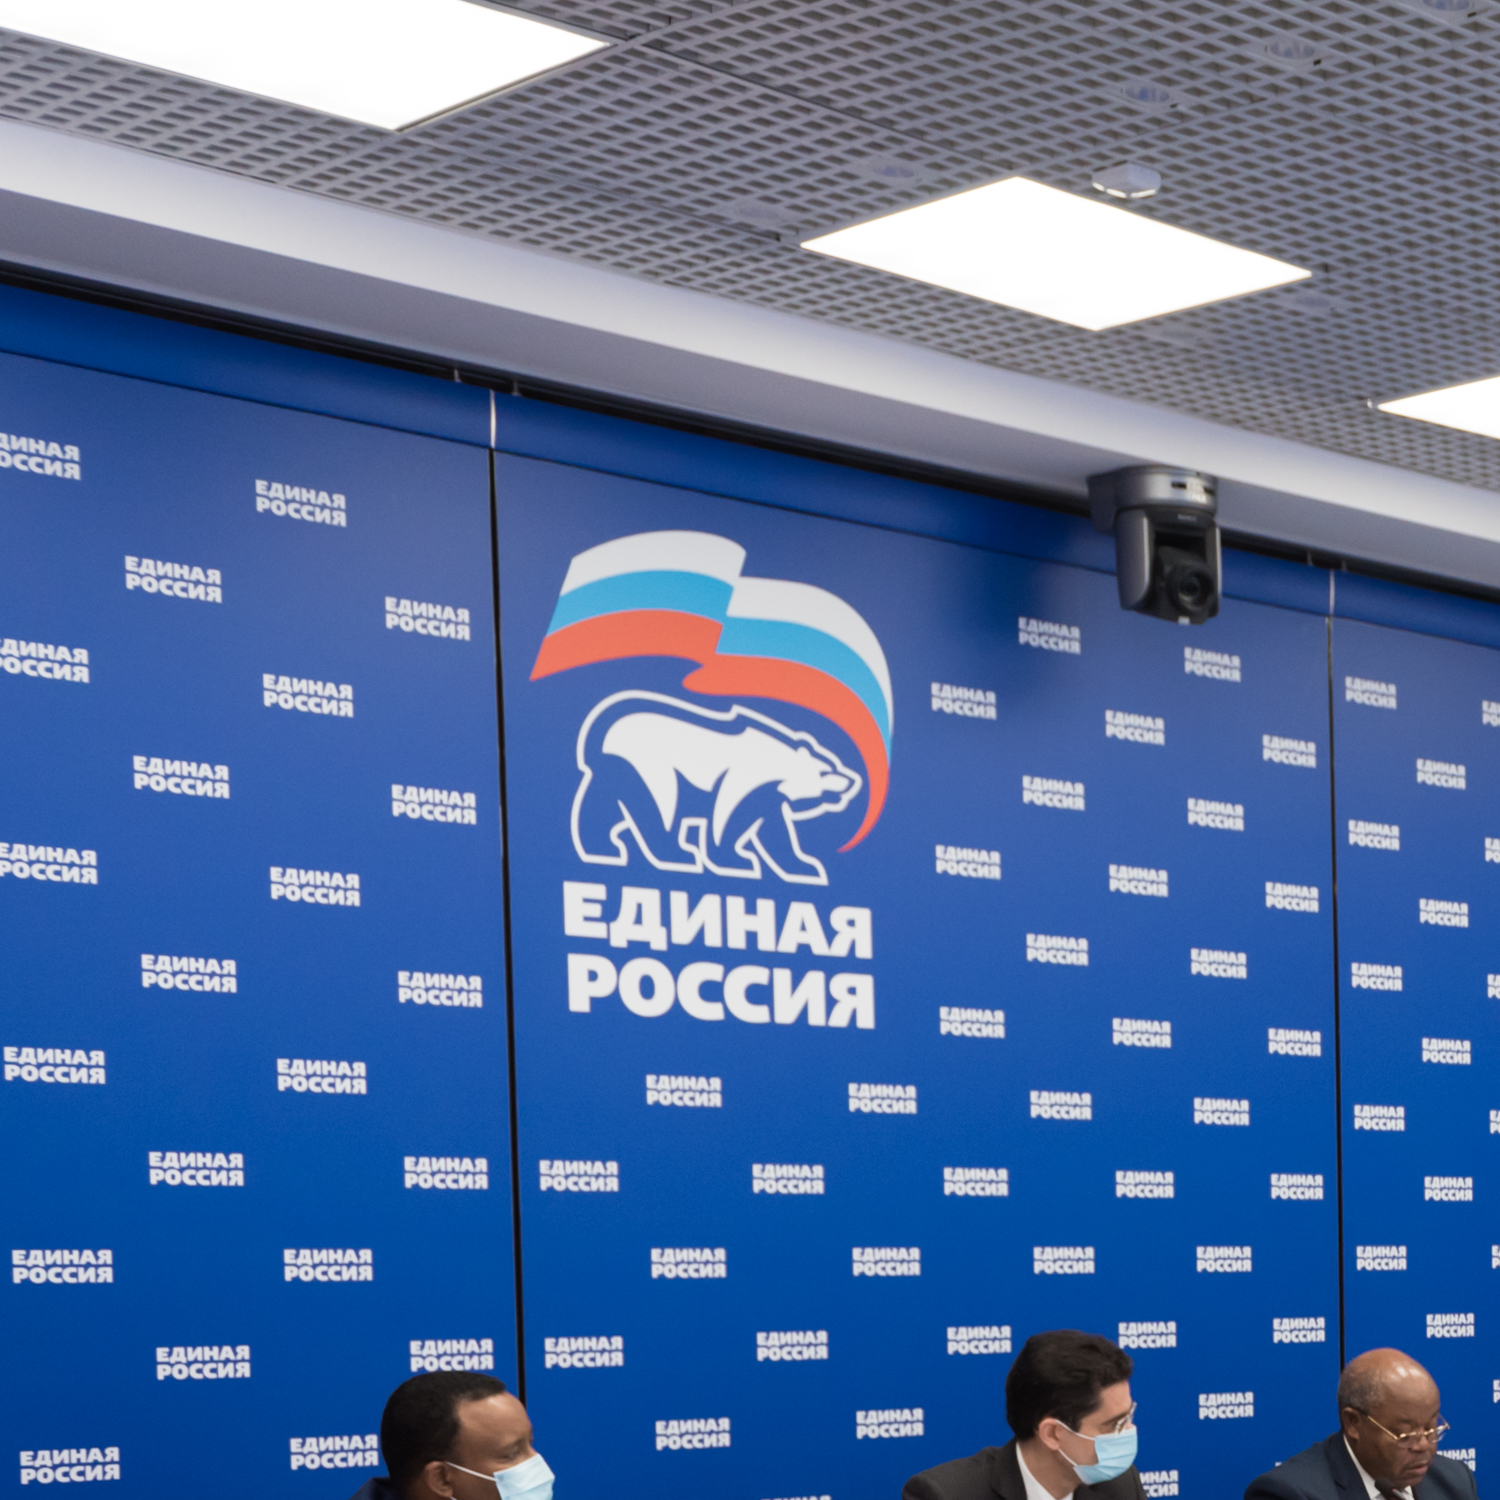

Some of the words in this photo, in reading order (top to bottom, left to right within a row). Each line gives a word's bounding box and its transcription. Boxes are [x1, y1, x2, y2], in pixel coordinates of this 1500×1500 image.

[0, 433, 80, 461] ДИНАЯ
[0, 450, 80, 480] ОССИЯ
[256, 480, 346, 509] ЕДИНАЯ
[256, 496, 346, 527] РОССИЯ
[125, 556, 221, 585] ЕДИНАЯ
[126, 573, 222, 603] РОССИЯ
[385, 596, 470, 624] ЕДИНАЯ
[386, 613, 470, 640] РОССИЯ
[0, 638, 88, 664] ДИНАЯ
[263, 674, 352, 700] ЕДИНАЯ
[931, 682, 996, 706] ЕДИНАЯ
[264, 690, 353, 717] РОССИЯ
[932, 696, 996, 720] РОССИЯ
[1105, 710, 1164, 732] ЕДИНАЯ
[1106, 723, 1165, 745] РОССИЯ
[133, 756, 229, 781] ЕДИНАЯ
[134, 773, 230, 798] РОССИЯ
[392, 784, 476, 808] ЕДИНАЯ
[392, 800, 476, 824] РОССИЯ
[1188, 798, 1244, 818] ЕДИНАЯ
[1188, 811, 1244, 831] РОССИЯ
[1348, 820, 1400, 838] ЕДИНАЯ
[1349, 832, 1400, 850] РОССИЯ
[936, 845, 1000, 866] ЕДИНАЯ
[270, 867, 360, 889] ЕДИНАЯ
[936, 859, 1001, 880] РОССИЯ
[1109, 864, 1168, 884] ЕДИНАЯ
[271, 883, 360, 906] РОССИЯ
[1109, 878, 1168, 897] РОССИЯ
[1266, 882, 1318, 900] ЕДИНАЯ
[1266, 894, 1319, 912] РОССИЯ
[1420, 898, 1468, 916] ЕДИНАЯ
[563, 881, 873, 959] ЕДИНАЯ
[1420, 910, 1468, 928] РОССИЯ
[1026, 934, 1088, 952] ЕДИНАЯ
[141, 954, 236, 975] ЕДИНАЯ
[1026, 947, 1088, 966] РОССИЯ
[1191, 948, 1246, 966] ЕДИНАЯ
[1191, 961, 1247, 979] РОССИЯ
[142, 971, 237, 993] РОССИЯ
[398, 971, 482, 991] ЕДИНАЯ
[398, 987, 482, 1008] РОССИЯ
[567, 953, 875, 1029] РОССИЯ
[940, 1006, 1004, 1024] ЕДИНАЯ
[940, 1020, 1005, 1038] РОССИЯ
[1112, 1018, 1171, 1035] ЕДИНАЯ
[1113, 1031, 1171, 1048] РОССИЯ
[4, 1047, 105, 1066] ЕДИНАЯ
[4, 1064, 106, 1084] РОССИЯ
[277, 1058, 366, 1077] ЕДИНАЯ
[278, 1075, 366, 1094] РОССИЯ
[646, 1074, 722, 1092] ЕДИНАЯ
[848, 1083, 916, 1100] ЕДИНАЯ
[646, 1089, 722, 1107] РОССИЯ
[849, 1097, 917, 1114] РОССИЯ
[1194, 1098, 1249, 1112] ЕДИНАЯ
[1194, 1110, 1250, 1126] РОССИЯ
[149, 1152, 243, 1168] ЕДИНАЯ
[404, 1156, 488, 1173] ЕДИНАЯ
[539, 1160, 618, 1176] ЕДИНАЯ
[150, 1168, 244, 1186] РОССИЯ
[404, 1172, 488, 1189] РОССИЯ
[752, 1164, 824, 1180] ЕДИНАЯ
[944, 1167, 1008, 1182] ЕДИНАЯ
[540, 1175, 619, 1192] РОССИЯ
[752, 1178, 824, 1194] РОССИЯ
[944, 1181, 1008, 1196] РОССИЯ
[1424, 1176, 1472, 1189] ЕДИНАЯ
[1424, 1188, 1473, 1201] РОССИЯ
[12, 1250, 112, 1266] ЕДИНАЯ
[284, 1249, 372, 1264] ЕДИНАЯ
[651, 1248, 726, 1263] ЕДИНАЯ
[852, 1247, 920, 1262] ЕДИНАЯ
[13, 1266, 113, 1284] РОССИЯ
[284, 1264, 373, 1282] РОССИЯ
[651, 1263, 726, 1278] РОССИЯ
[853, 1261, 920, 1276] РОССИЯ
[545, 1336, 623, 1353] ЕДИНАЯ
[756, 1330, 828, 1346] ЕДИНАЯ
[156, 1345, 250, 1363] ЕДИНАЯ
[545, 1351, 624, 1368] РОССИЯ
[757, 1345, 828, 1361] РОССИЯ
[157, 1362, 250, 1380] РОССИЯ
[656, 1418, 730, 1435] ЕДИНАЯ
[290, 1434, 378, 1453] ЕДИНАЯ
[656, 1432, 730, 1450] РОССИЯ
[20, 1447, 119, 1467] ЕДИНАЯ
[290, 1450, 378, 1470] РОССИЯ
[21, 1464, 120, 1484] РОССИЯ
